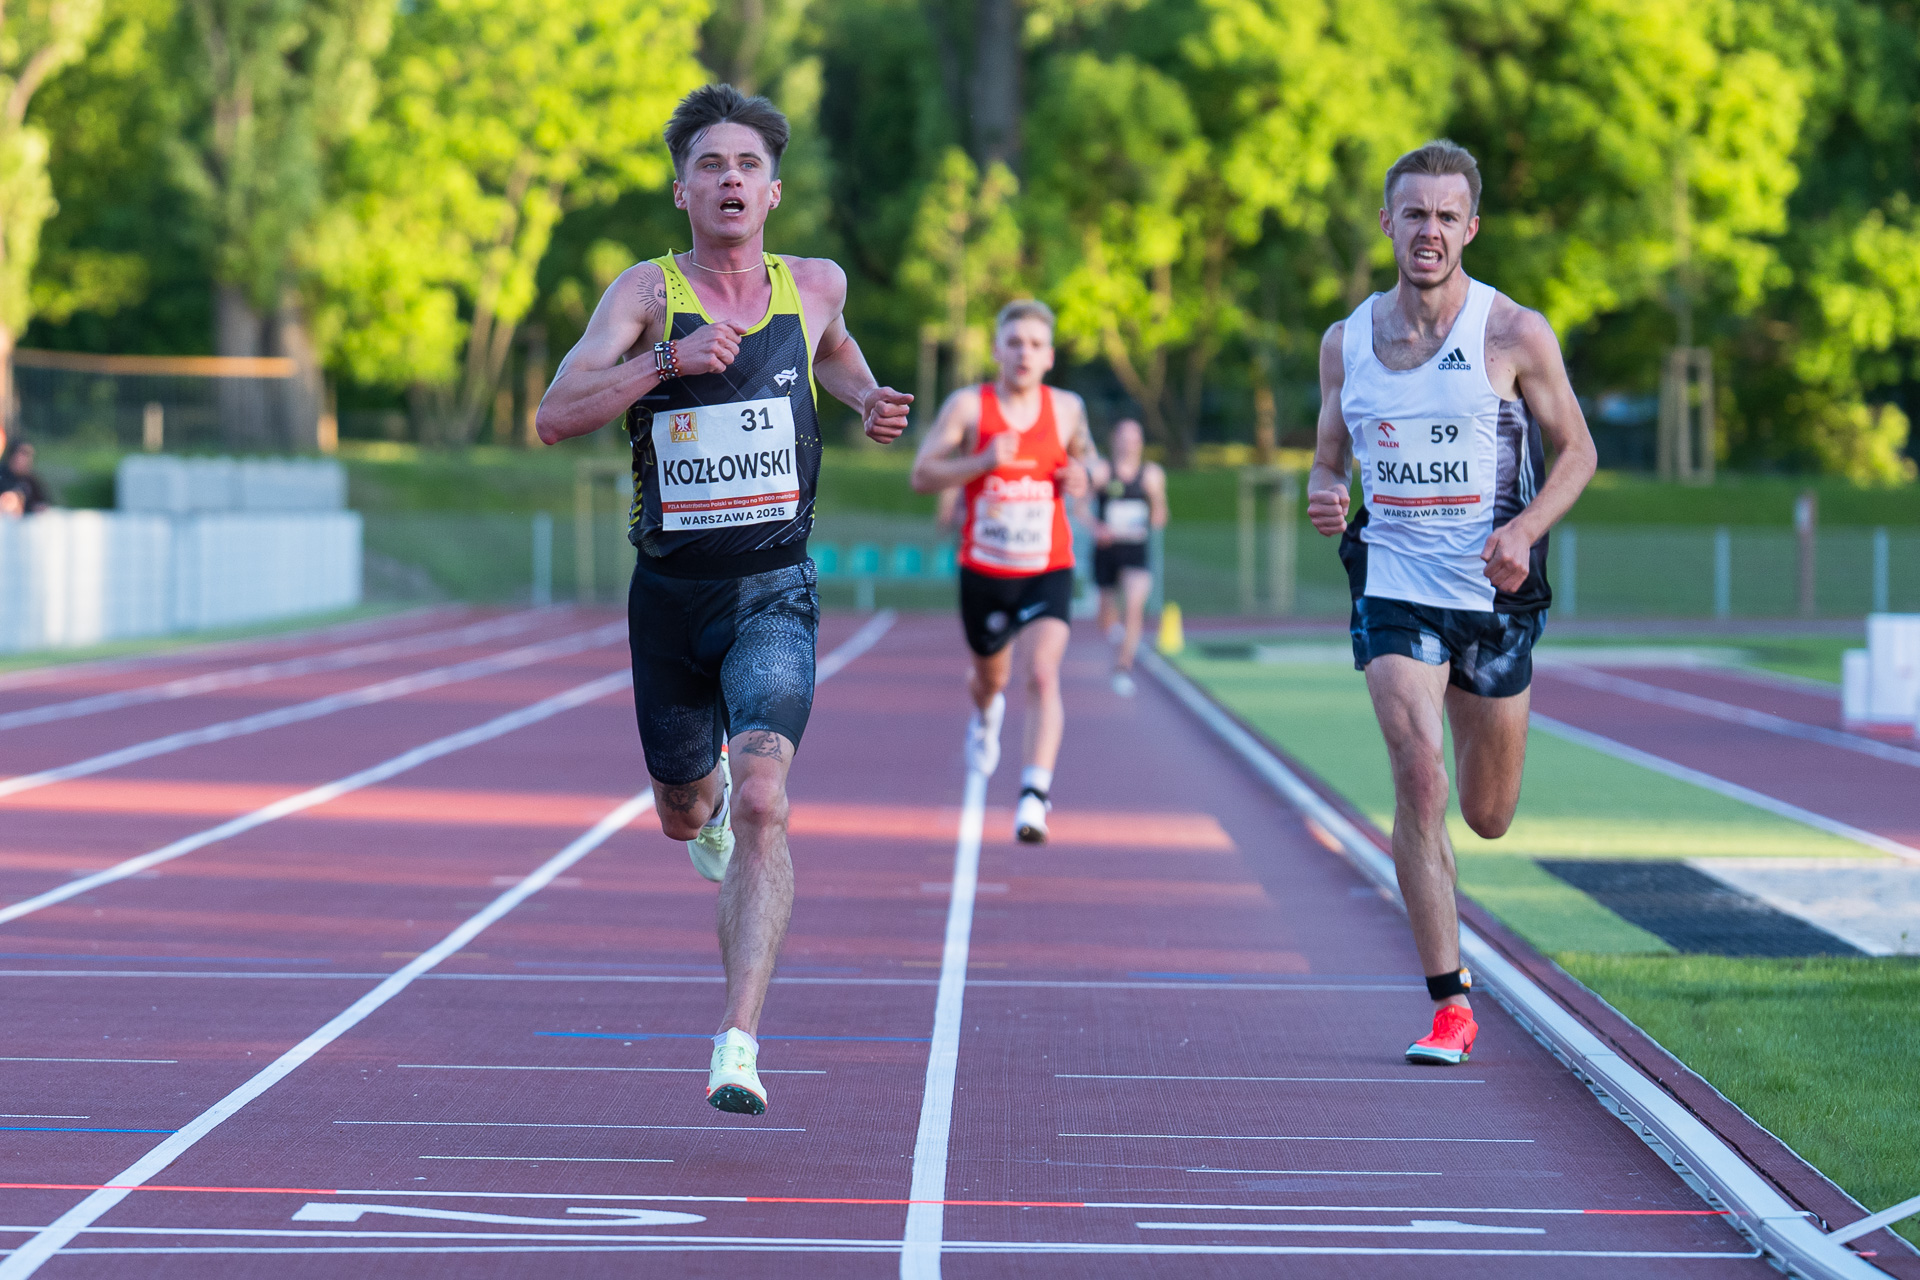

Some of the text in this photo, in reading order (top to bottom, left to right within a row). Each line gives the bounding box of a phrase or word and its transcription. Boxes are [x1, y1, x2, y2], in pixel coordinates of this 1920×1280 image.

[1438, 361, 1471, 370] adidas
[740, 407, 774, 432] 31
[1430, 424, 1458, 444] 59
[1378, 440, 1399, 448] ORLEN
[663, 448, 791, 486] KOZŁOWSKI
[1377, 460, 1468, 484] SKALSKI
[680, 507, 785, 525] WARSZAWA 2025
[1384, 508, 1439, 518] WARSZAWA
